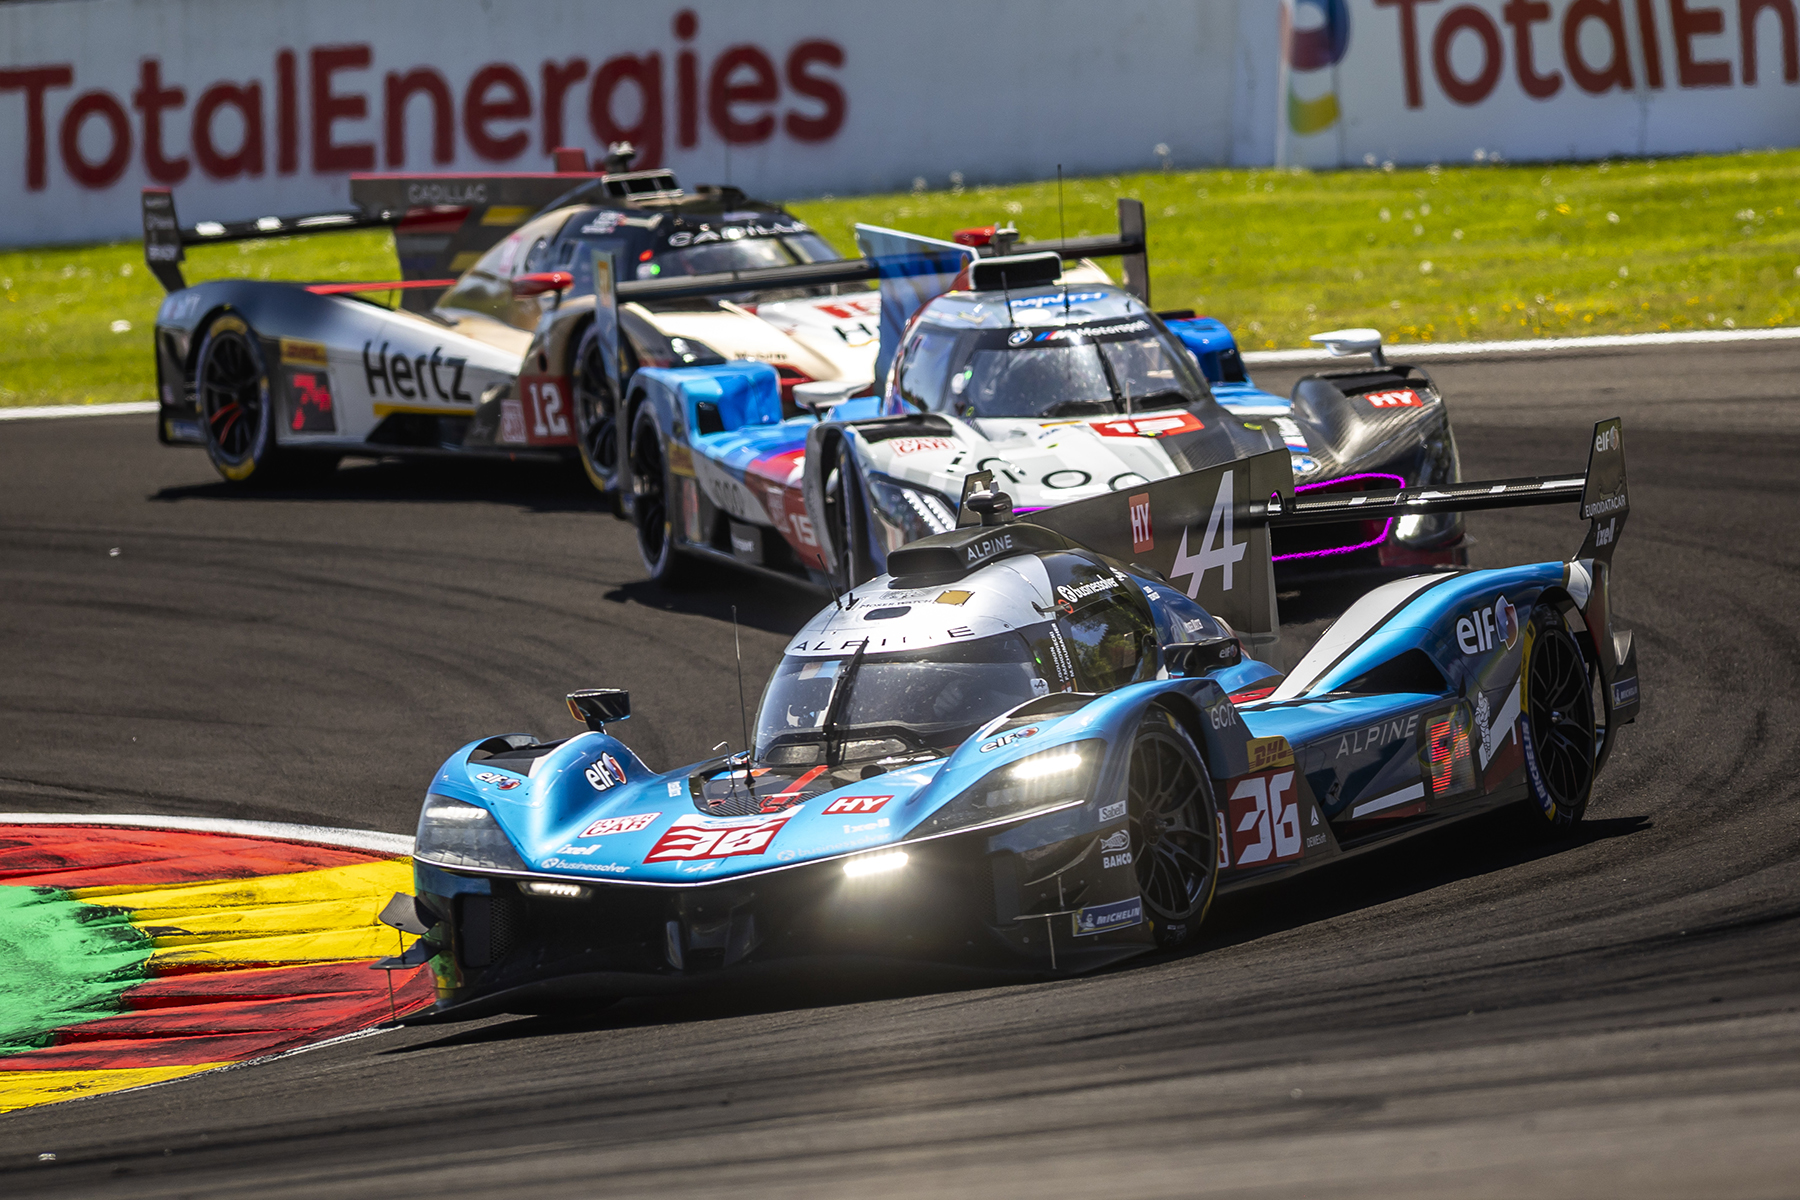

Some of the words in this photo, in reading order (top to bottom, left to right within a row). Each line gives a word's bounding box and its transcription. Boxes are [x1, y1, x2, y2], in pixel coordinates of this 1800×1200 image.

[0, 10, 847, 191] TotalEnergies
[408, 183, 488, 204] CADILLAC
[362, 340, 473, 403] Hertz
[529, 383, 569, 436] 12
[1368, 390, 1413, 407] HY
[1595, 431, 1609, 452] elf
[1585, 495, 1626, 517] EURODATACAR
[789, 513, 818, 547] 15
[1131, 502, 1150, 544] HY
[1596, 517, 1616, 547] ixell
[967, 534, 1013, 561] ALPINE
[791, 626, 976, 651] ALPIE
[1456, 605, 1495, 655] elf
[979, 732, 1018, 753] elf
[1335, 714, 1420, 760] ALPINE
[1253, 739, 1288, 767] DHL
[475, 772, 507, 784] elf
[584, 759, 616, 792] elf
[827, 797, 890, 812] HY
[1101, 803, 1125, 820] Sabelt
[586, 820, 647, 835] CAR
[843, 818, 891, 834] ixell
[1230, 770, 1302, 866] 36
[556, 843, 602, 856] ixell
[648, 820, 786, 859] 36
[797, 833, 891, 857] businessolver
[556, 859, 631, 873] businessolver
[1102, 852, 1132, 869] BAHCO
[1096, 907, 1141, 925] MICHELIN
